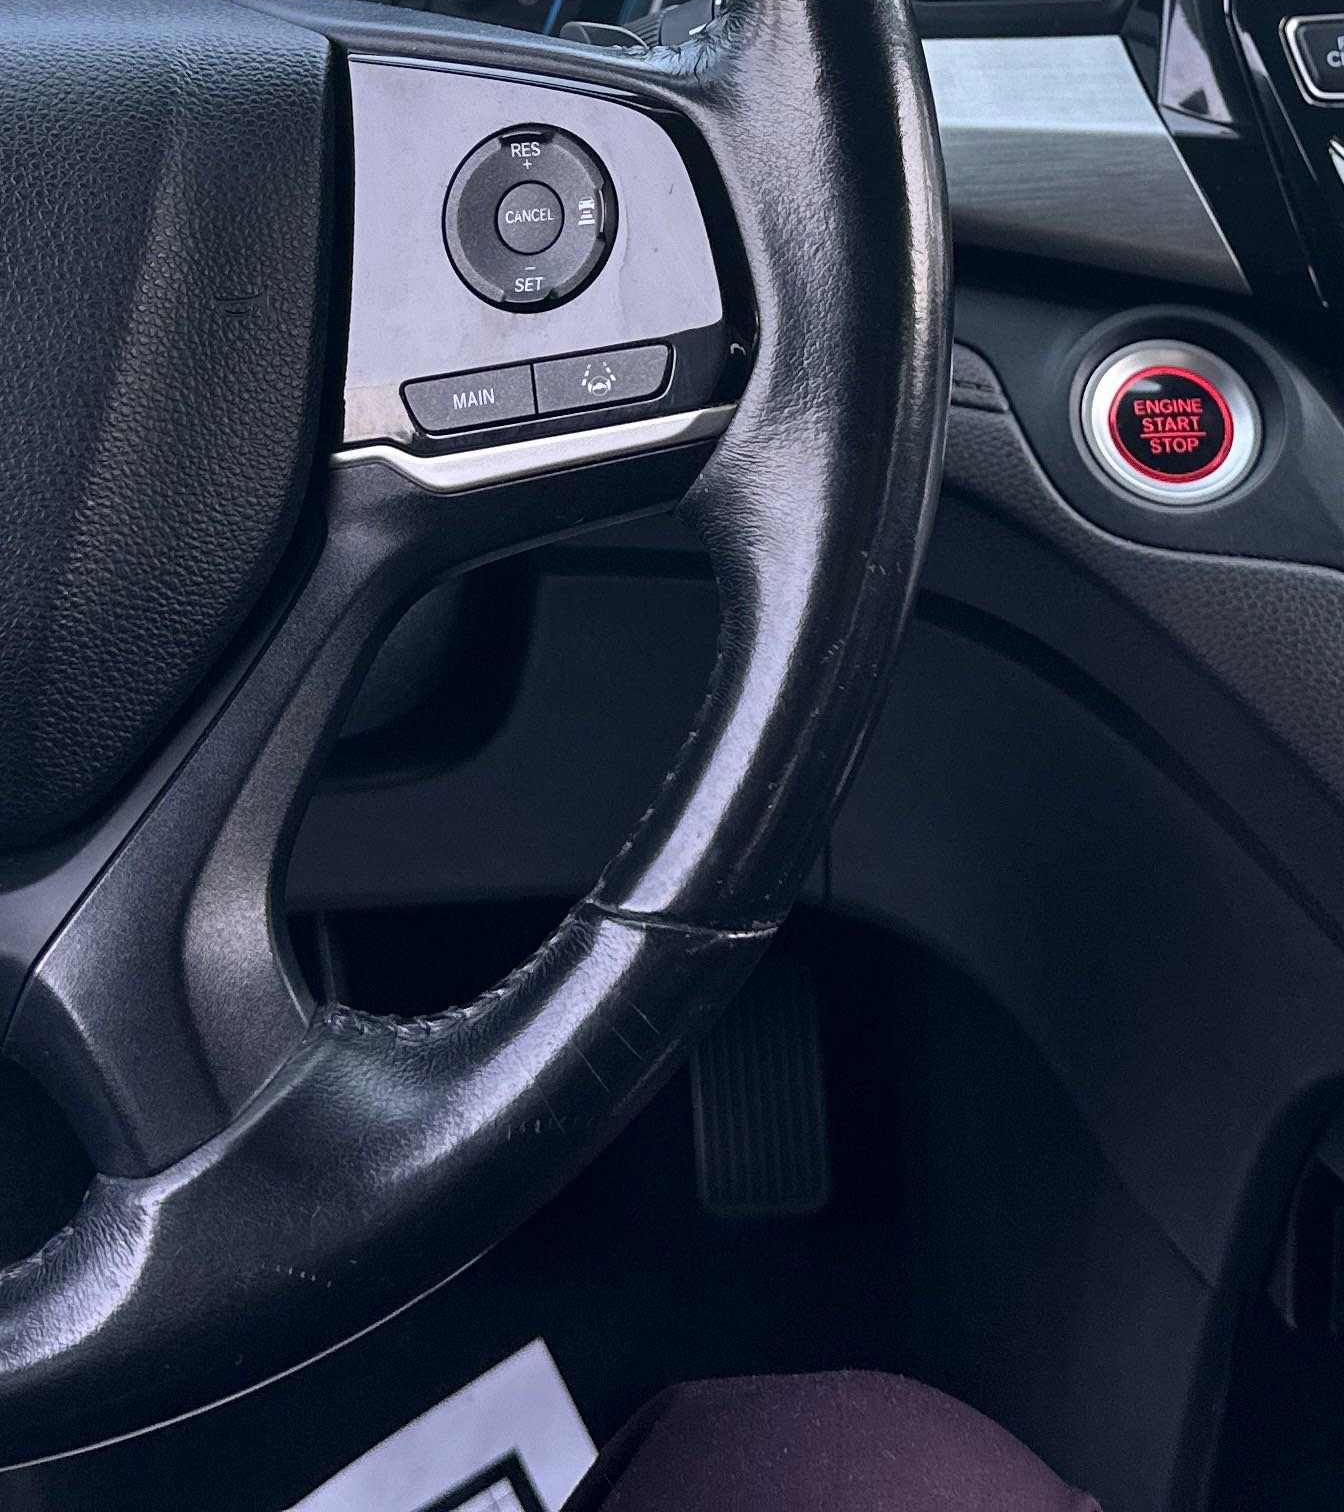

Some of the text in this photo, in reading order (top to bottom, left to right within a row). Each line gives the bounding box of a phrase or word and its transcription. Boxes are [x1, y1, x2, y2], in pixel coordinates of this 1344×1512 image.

[510, 141, 541, 159] RES
[504, 207, 555, 225] CANCEL
[514, 276, 544, 294] SET
[452, 388, 496, 411] MAIN
[1133, 398, 1204, 415] ENGINE
[1142, 415, 1201, 433] START
[1151, 438, 1199, 455] STOP
